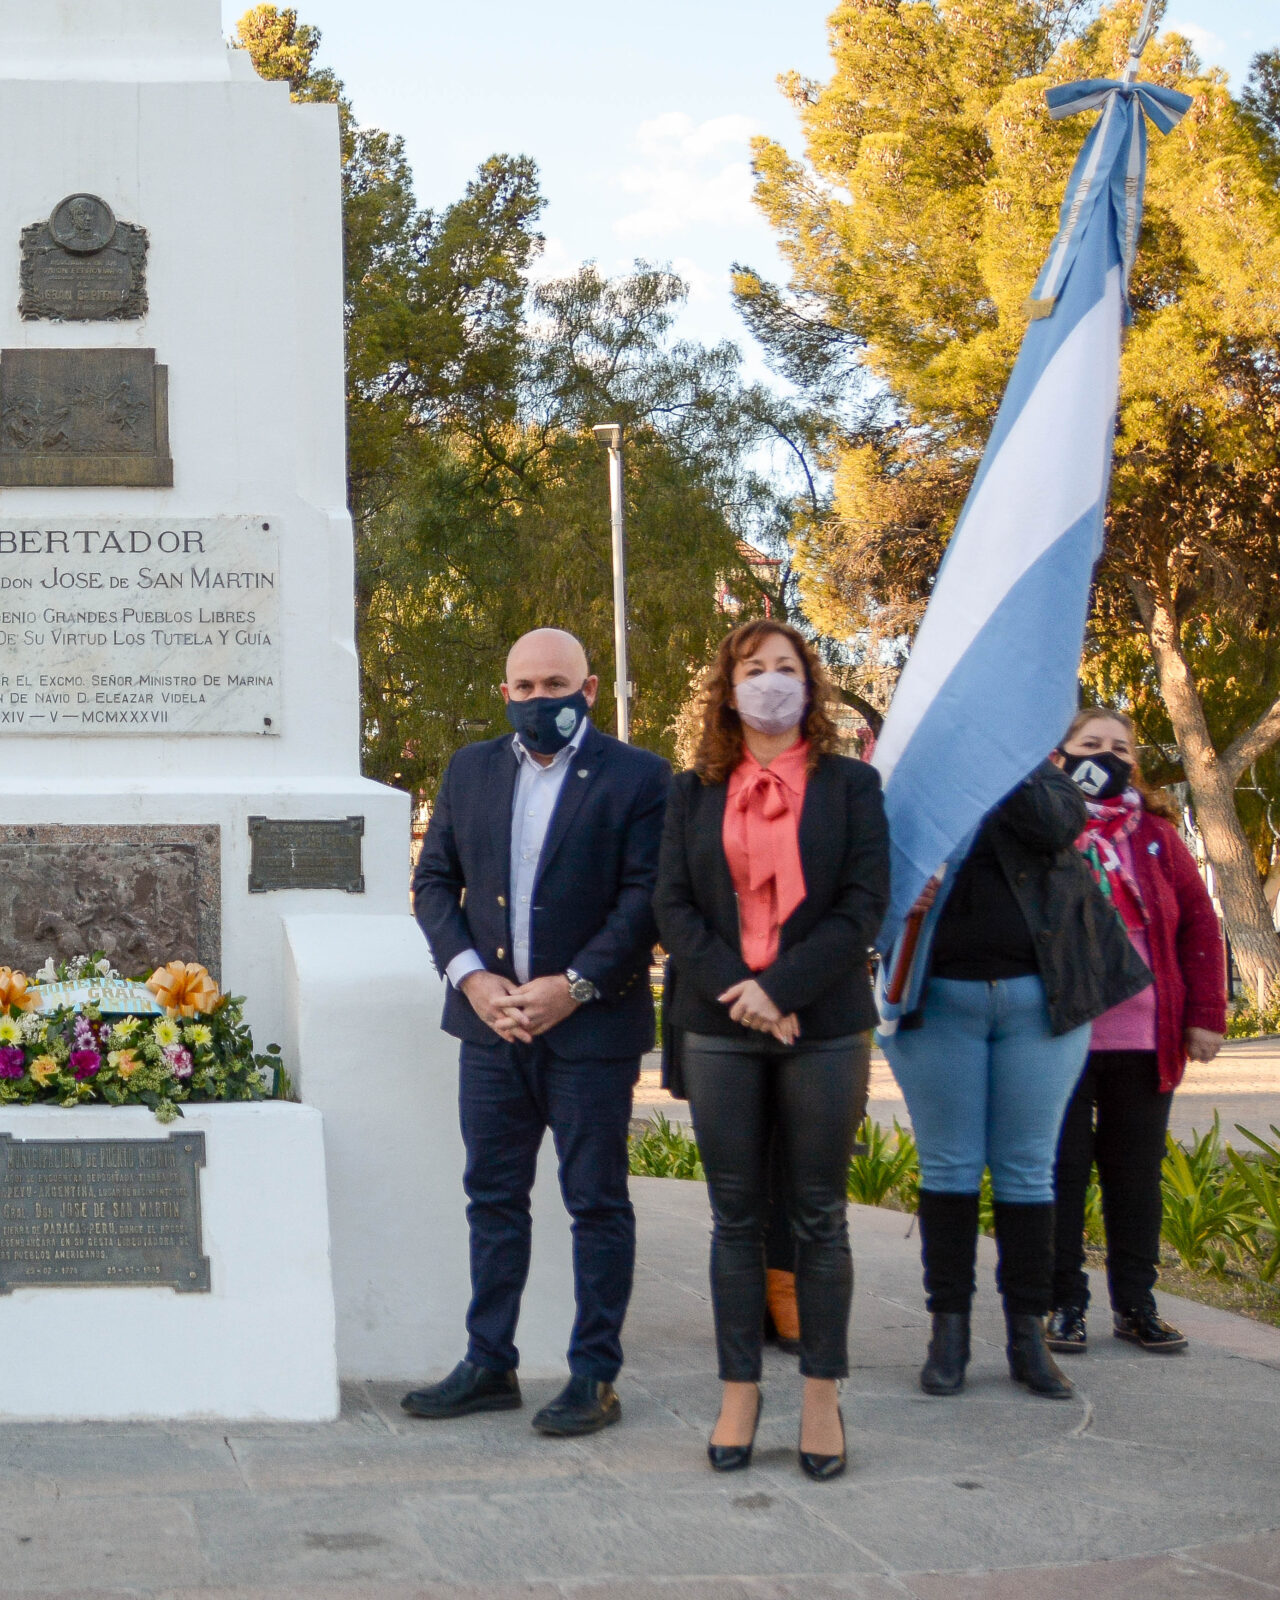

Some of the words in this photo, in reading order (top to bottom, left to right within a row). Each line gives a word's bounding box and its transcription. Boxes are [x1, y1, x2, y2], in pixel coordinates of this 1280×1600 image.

[0, 576, 33, 589] DON
[39, 566, 104, 590] JOSE
[109, 575, 130, 589] DE
[136, 566, 184, 589] SAN
[190, 566, 275, 589] MARTIN
[42, 607, 118, 624] GRANDES
[122, 607, 193, 624] PUEBLOS
[198, 607, 256, 624] LIBRES
[23, 629, 45, 646] SU
[50, 629, 107, 646] VIRTUD
[113, 629, 145, 646] LOS
[151, 629, 213, 646] TUTELA
[218, 629, 229, 646] Y
[16, 674, 32, 687] EL
[91, 674, 133, 687] SEÑOR
[139, 674, 197, 687] MINISTRO
[203, 674, 221, 687] DE
[227, 674, 274, 687] MARINA
[10, 692, 28, 704] DE
[77, 692, 90, 704] D.
[161, 692, 206, 704] VIDELA
[50, 711, 59, 724] V
[82, 711, 168, 724] MCMXXXVII
[93, 1202, 106, 1218] DE
[112, 1202, 133, 1218] SAN
[139, 1201, 180, 1218] MARTIN
[60, 1237, 72, 1247] EN
